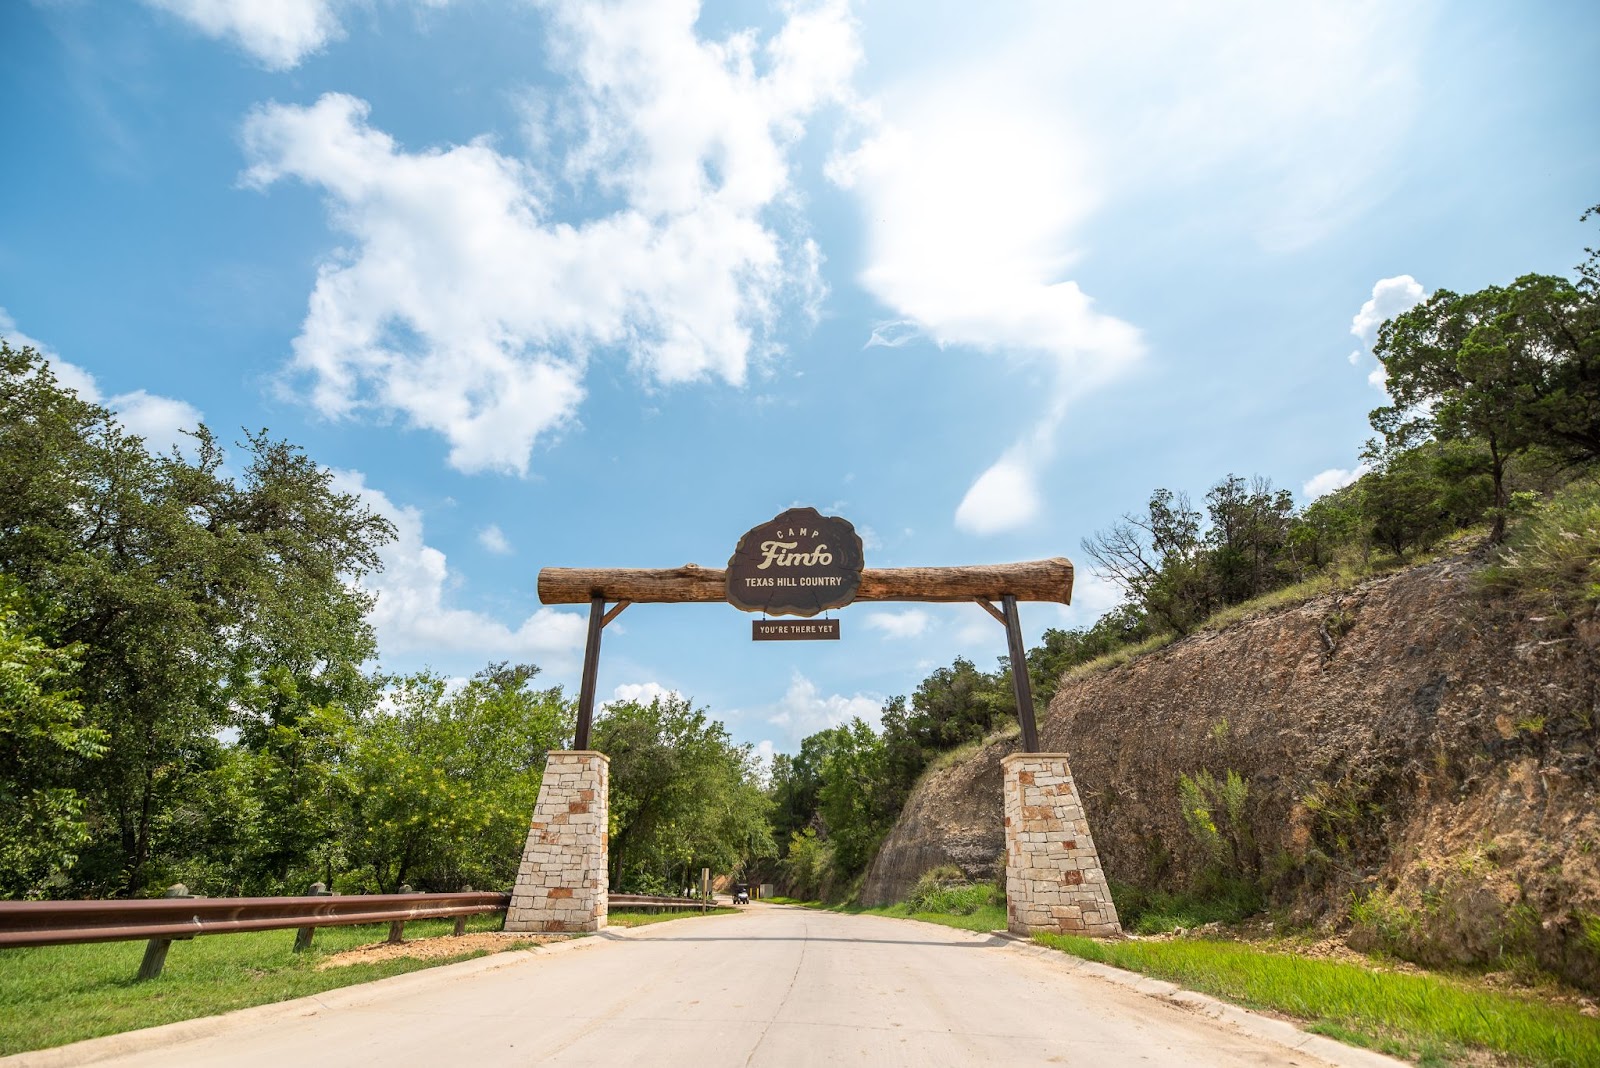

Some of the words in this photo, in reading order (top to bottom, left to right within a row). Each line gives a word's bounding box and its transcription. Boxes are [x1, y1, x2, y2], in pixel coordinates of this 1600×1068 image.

[776, 527, 819, 539] CAMP
[757, 541, 833, 570] Fimfo
[745, 577, 774, 587] TEXAS
[777, 577, 797, 587] HILL
[800, 576, 842, 587] COUNTRY
[760, 626, 788, 634] YOU'RE
[791, 625, 816, 633] THERE
[818, 625, 833, 633] YET
